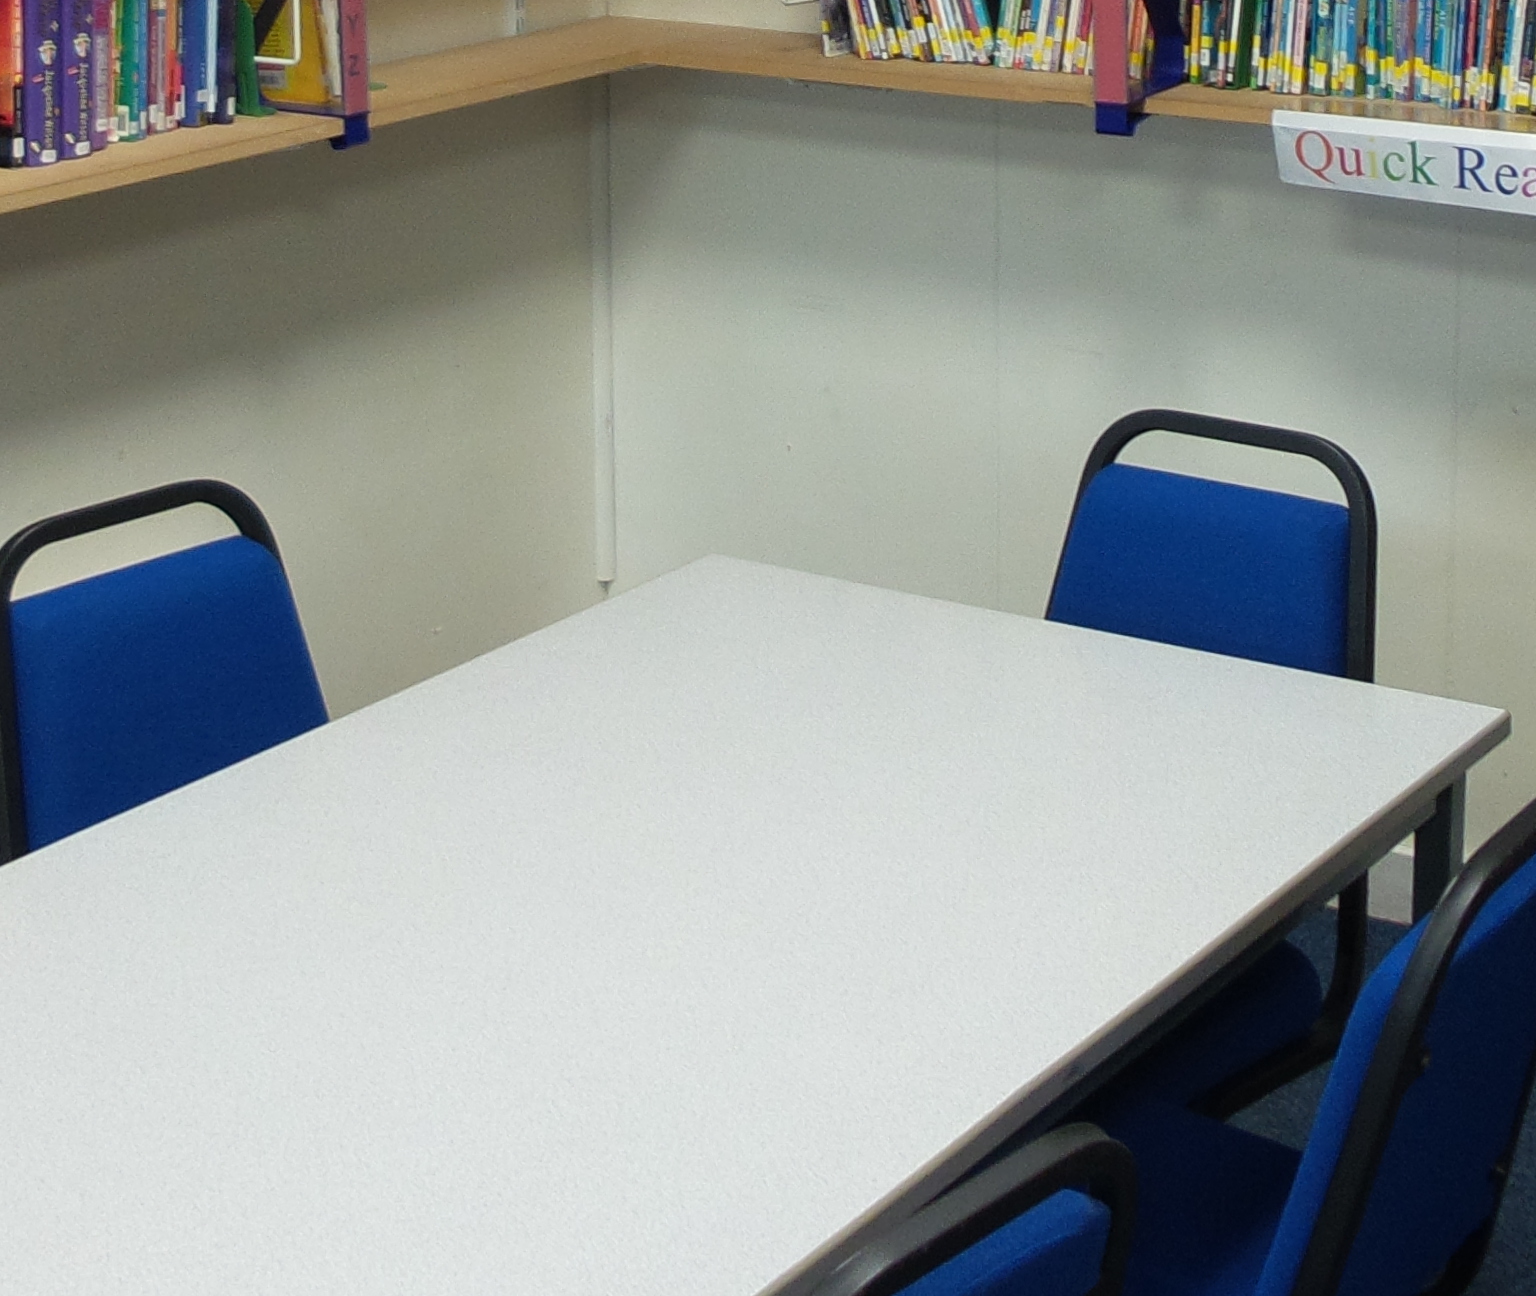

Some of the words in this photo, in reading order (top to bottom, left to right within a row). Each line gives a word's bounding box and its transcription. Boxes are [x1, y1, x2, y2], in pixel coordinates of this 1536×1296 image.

[348, 13, 359, 38] Y
[349, 54, 360, 77] Z
[1293, 129, 1438, 186] Quick
